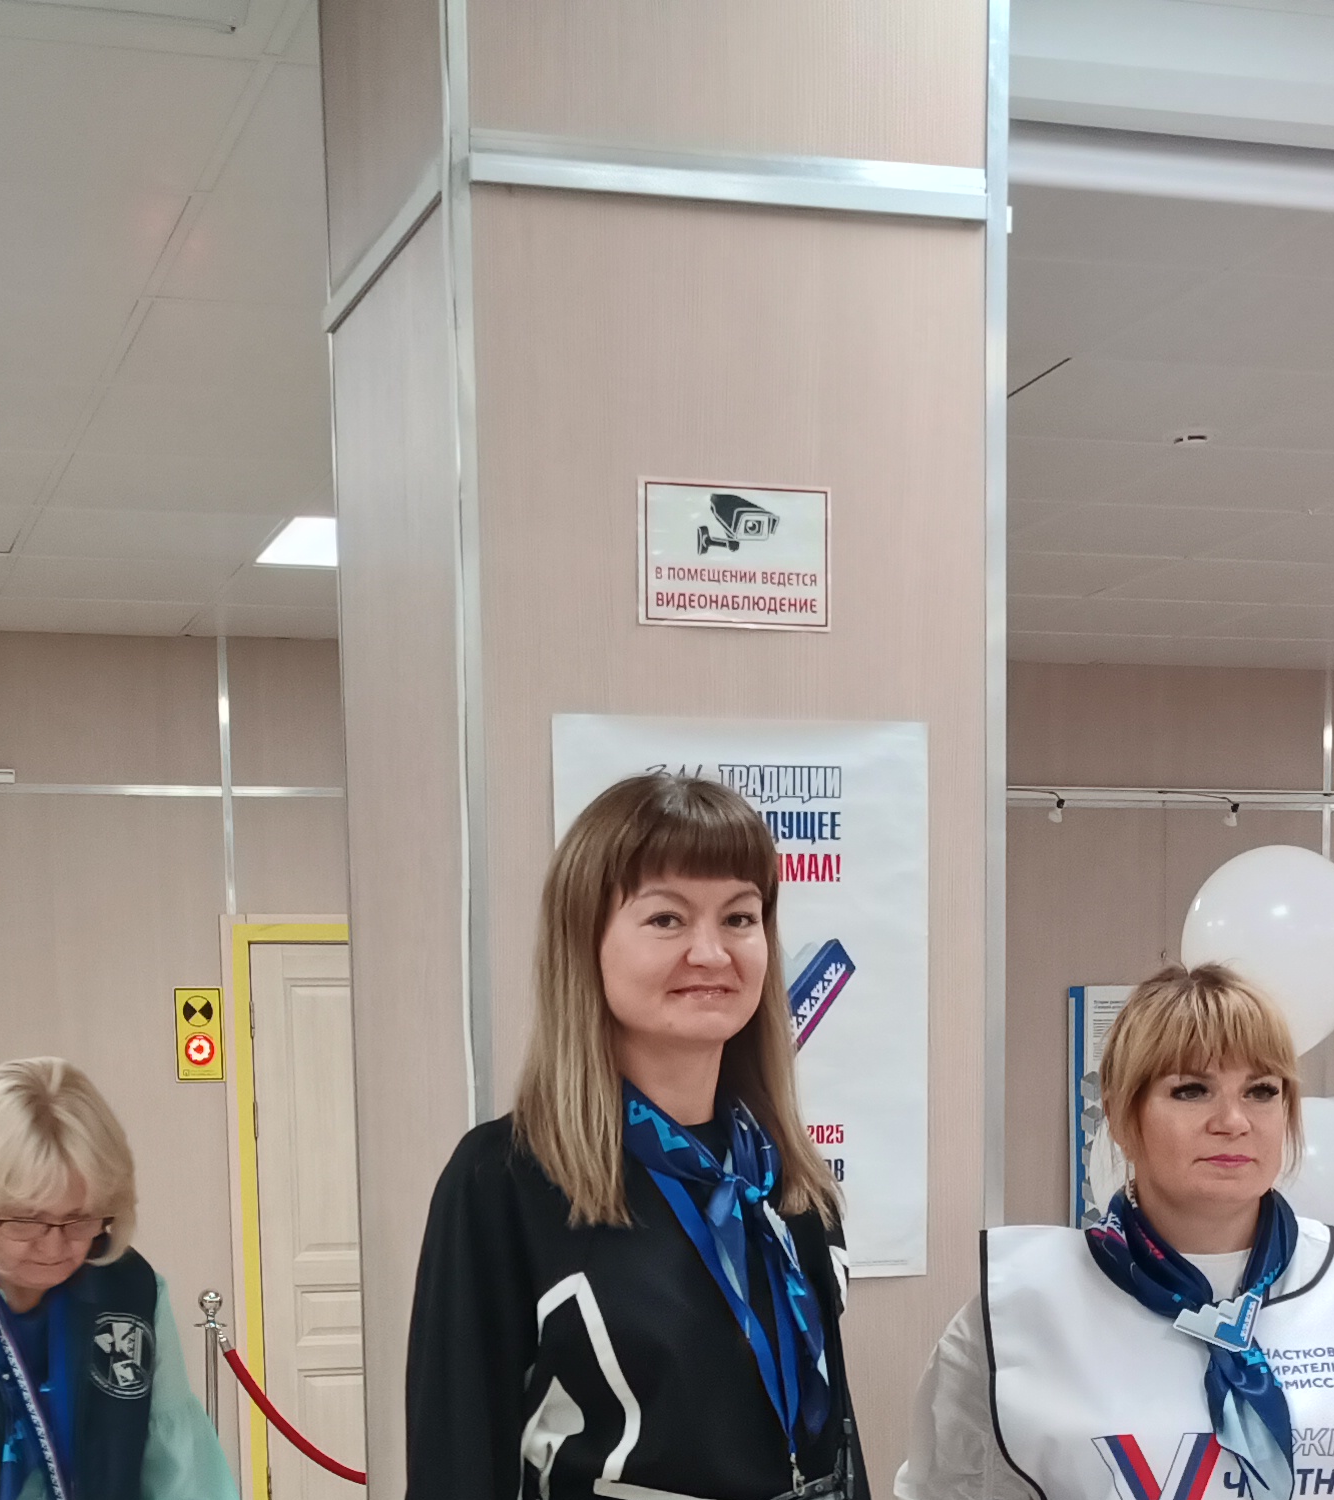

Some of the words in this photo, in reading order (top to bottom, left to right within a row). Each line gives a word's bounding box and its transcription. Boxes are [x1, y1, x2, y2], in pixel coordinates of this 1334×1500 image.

[655, 566, 663, 580] В
[667, 567, 756, 585] ПОМЕЩЕНИИ
[761, 572, 818, 588] ВЕДЕТСЯ
[656, 592, 818, 615] ВИДЕОНАБЛЮДЕНИЕ
[718, 764, 842, 804] ТРАДИЦИИ
[758, 811, 841, 844] ДУЩЕЕ
